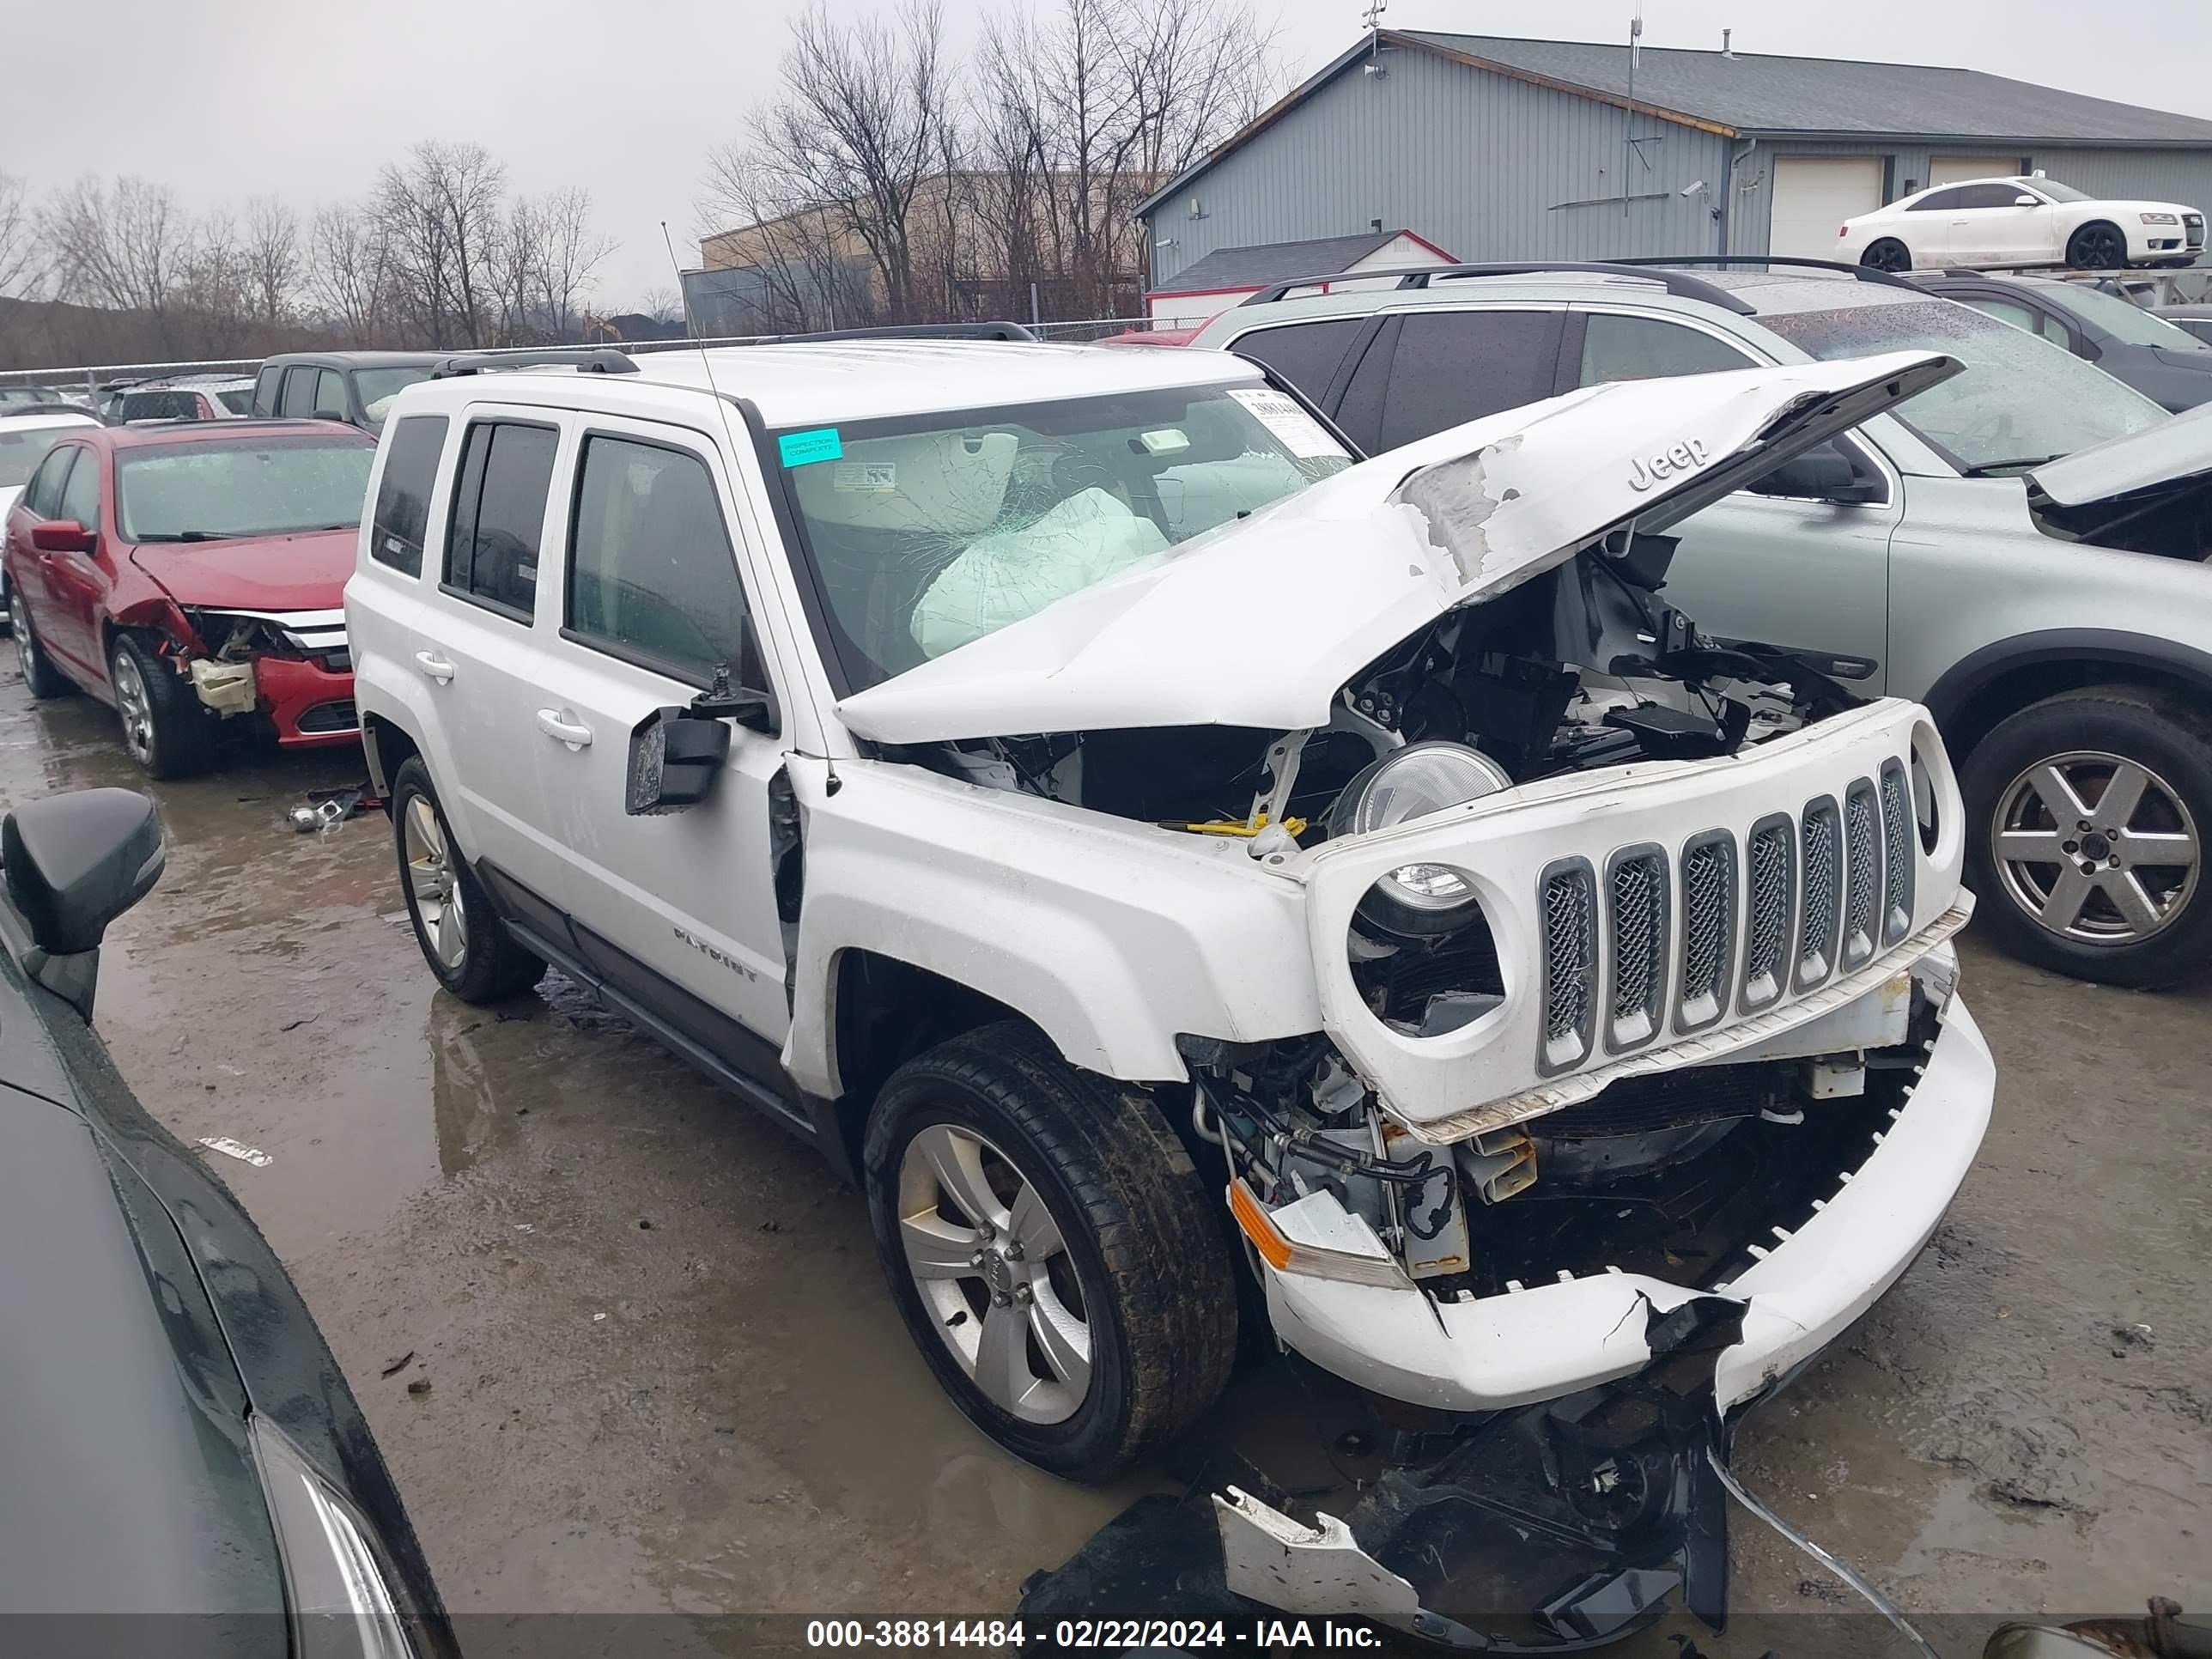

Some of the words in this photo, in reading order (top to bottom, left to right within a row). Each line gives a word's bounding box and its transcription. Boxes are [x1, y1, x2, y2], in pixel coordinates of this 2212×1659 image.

[785, 438, 833, 451] INSPECTION
[789, 445, 833, 456] COMPLETE
[1628, 435, 1710, 492] Jeep
[673, 927, 757, 983] PATRIOT
